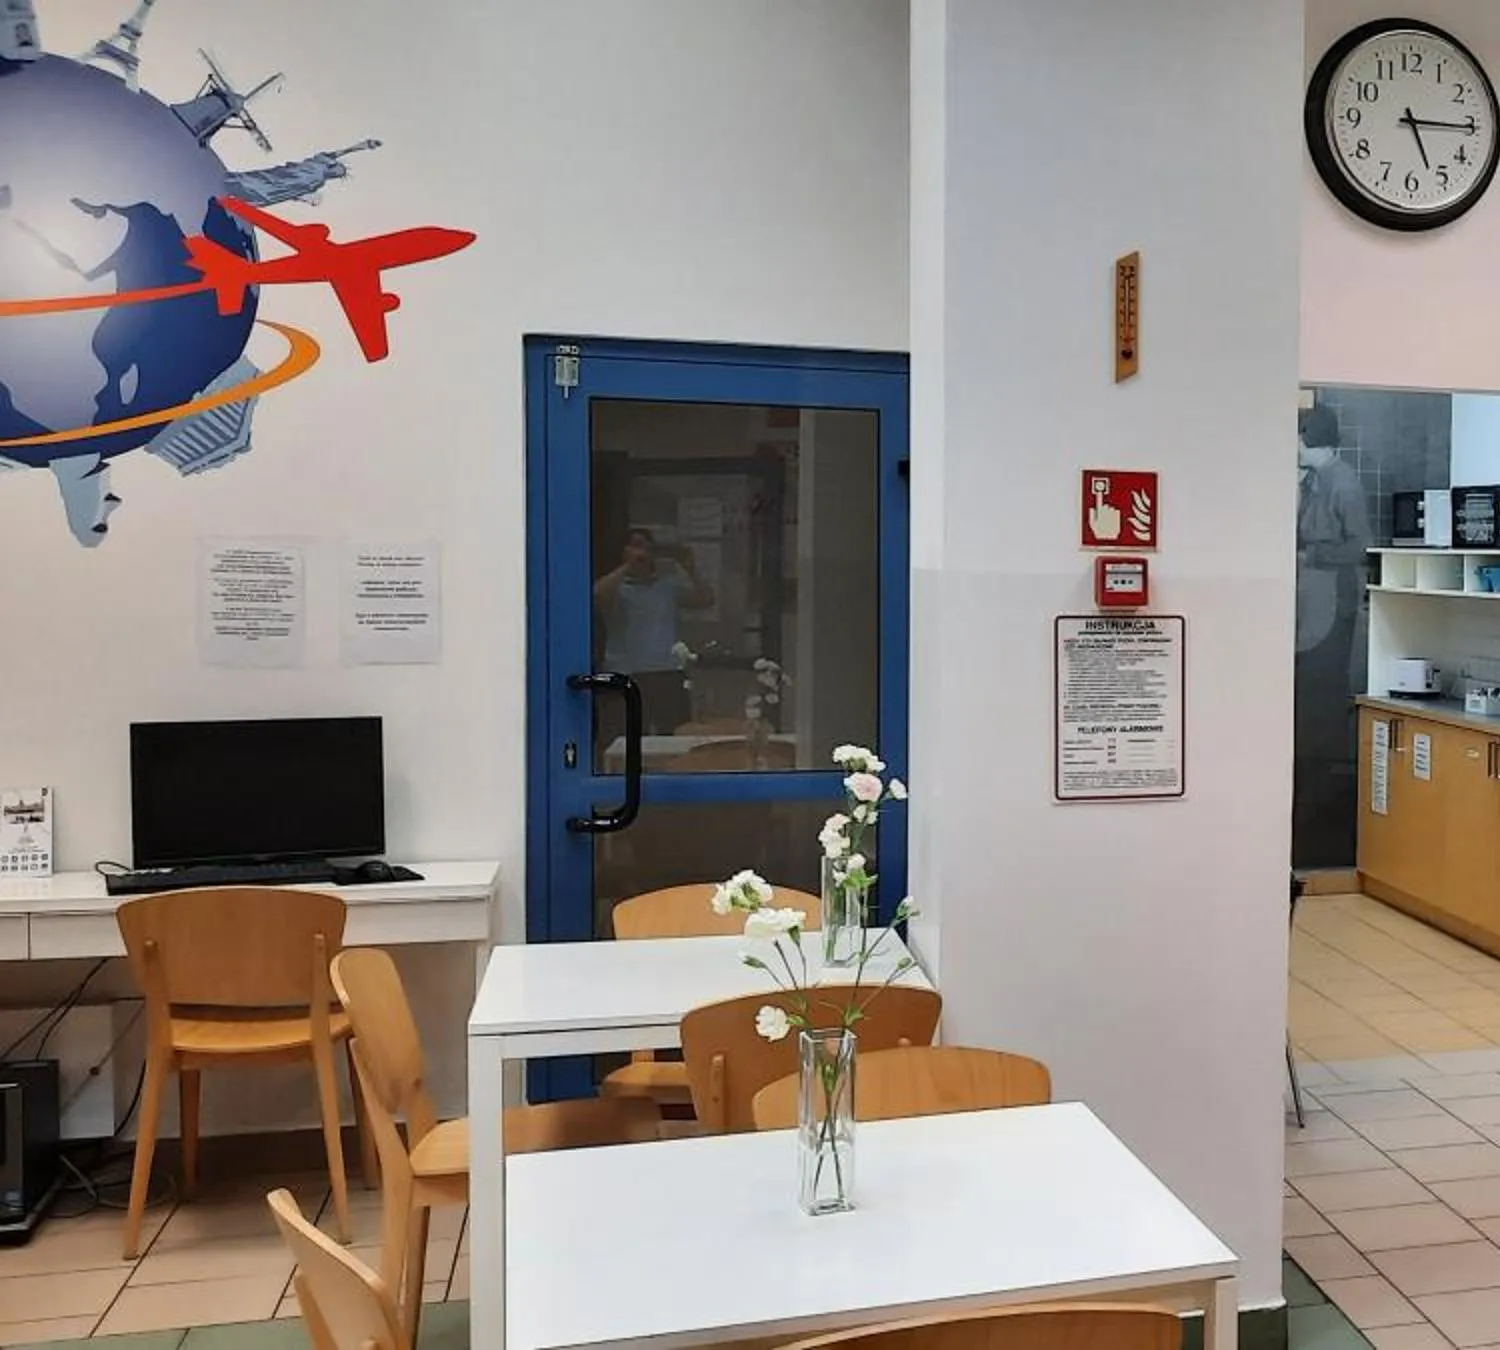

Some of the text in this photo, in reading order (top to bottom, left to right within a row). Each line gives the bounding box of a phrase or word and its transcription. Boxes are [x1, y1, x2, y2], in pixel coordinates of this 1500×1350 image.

[1376, 59, 1394, 81] 11
[1401, 52, 1423, 75] 12
[1435, 62, 1442, 84] 1
[1356, 81, 1379, 103] 10
[1452, 83, 1466, 105] 2
[1346, 107, 1362, 129] 9
[1464, 115, 1476, 137] 3
[1355, 138, 1371, 160] 8
[1453, 143, 1468, 165] 4
[1379, 161, 1393, 182] 7
[1404, 170, 1420, 193] 6
[1435, 164, 1450, 187] 5
